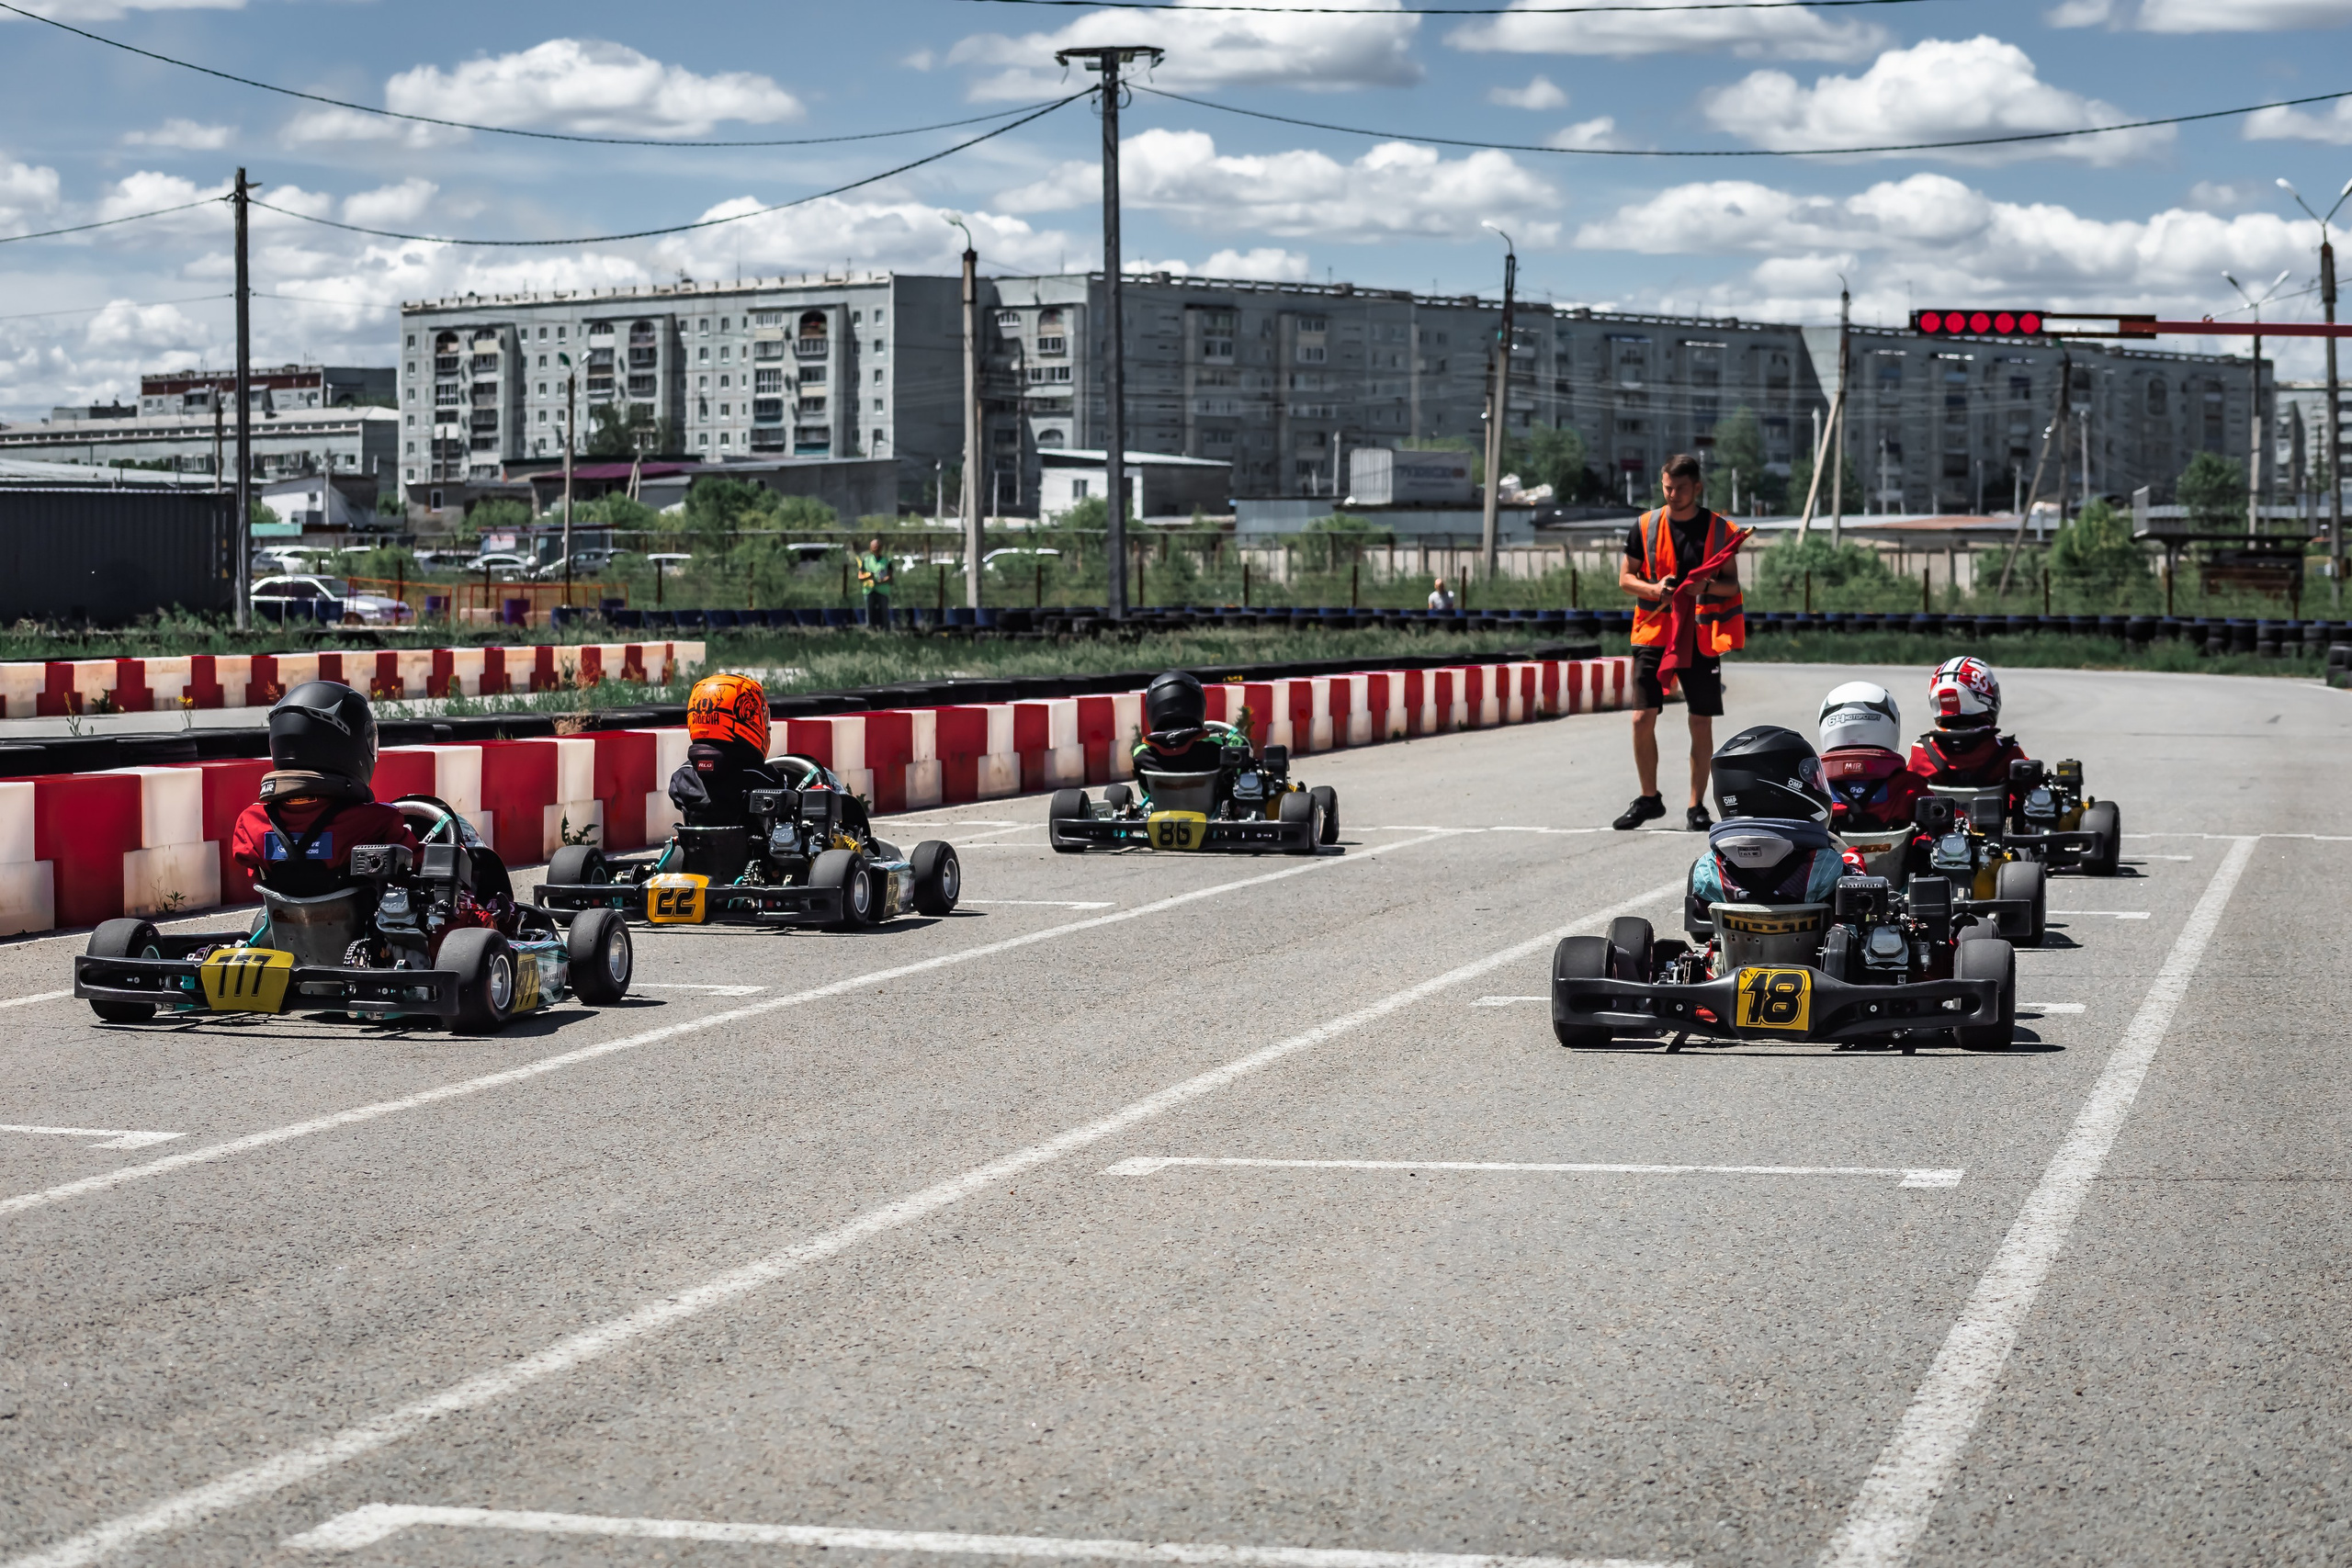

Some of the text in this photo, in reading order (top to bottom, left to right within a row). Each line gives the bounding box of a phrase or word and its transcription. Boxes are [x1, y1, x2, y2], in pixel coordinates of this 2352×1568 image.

[1970, 671, 1988, 691] 93
[1788, 779, 1803, 790] OMP
[655, 880, 698, 917] 22
[215, 953, 275, 998] 777
[1742, 970, 1807, 1026] 18
